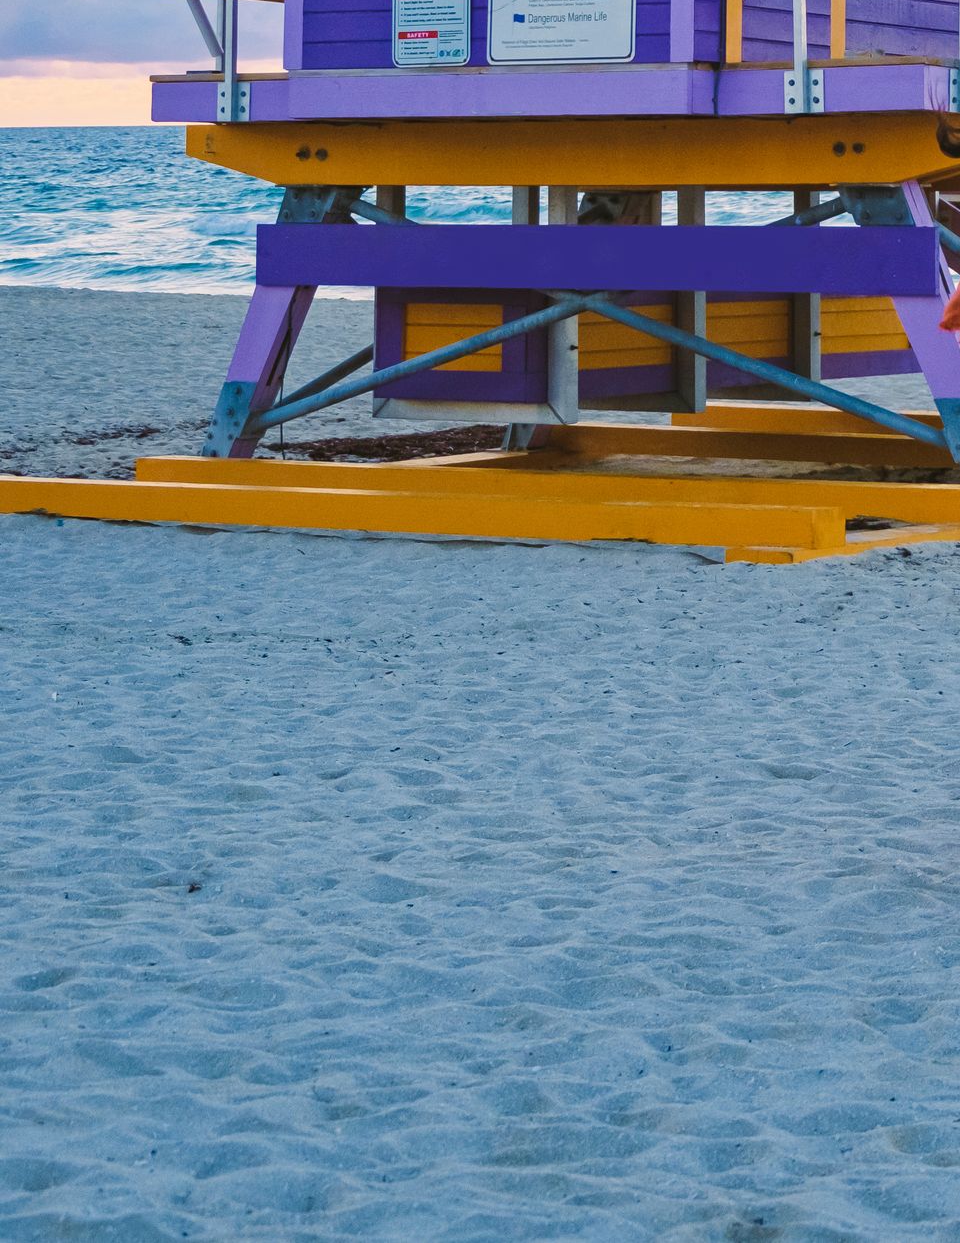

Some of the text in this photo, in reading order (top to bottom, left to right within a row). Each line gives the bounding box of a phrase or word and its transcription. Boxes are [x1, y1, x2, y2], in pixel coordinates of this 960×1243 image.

[528, 11, 608, 25] Dangerous Marine Life
